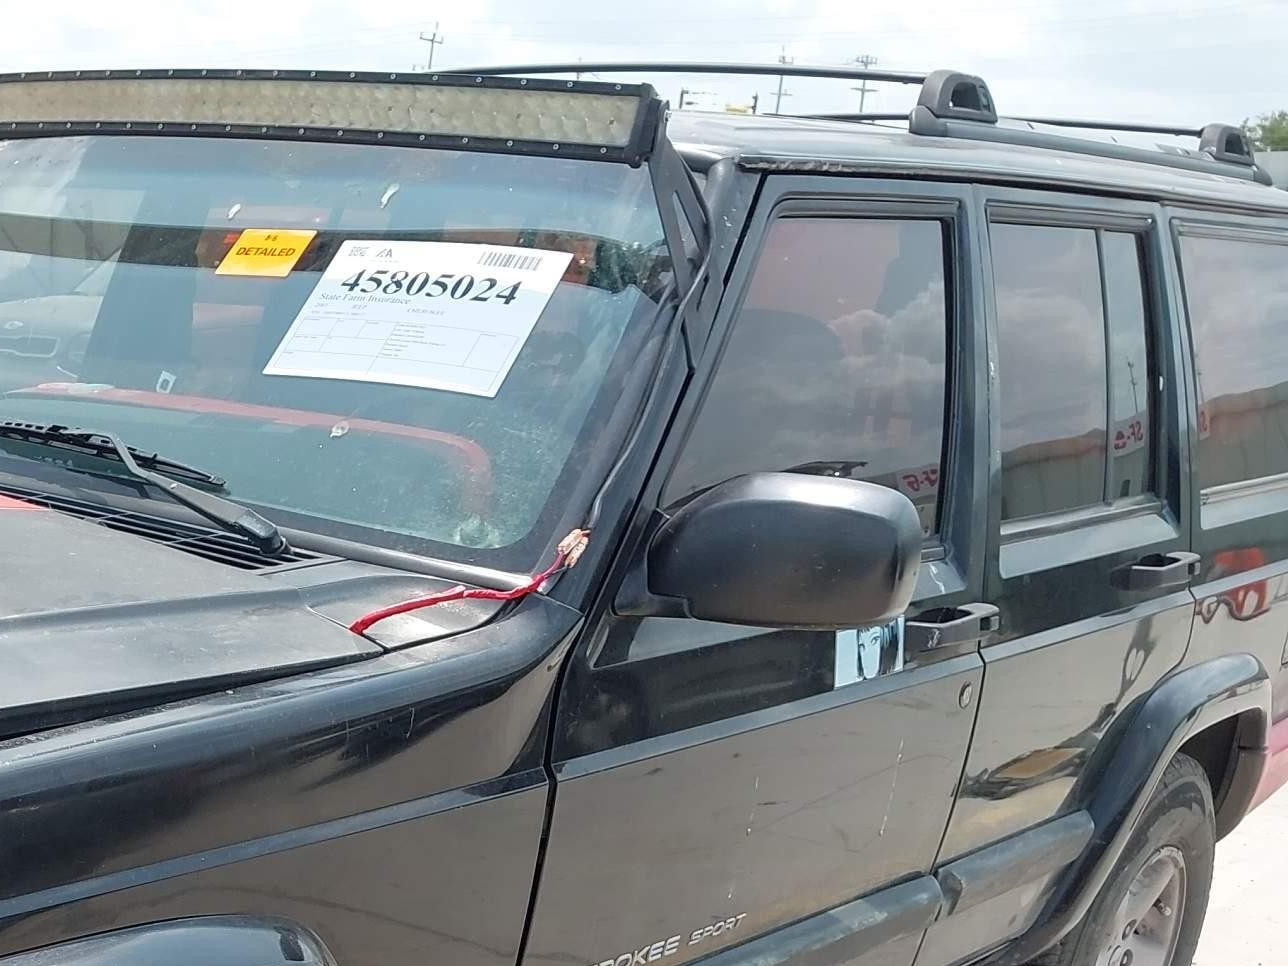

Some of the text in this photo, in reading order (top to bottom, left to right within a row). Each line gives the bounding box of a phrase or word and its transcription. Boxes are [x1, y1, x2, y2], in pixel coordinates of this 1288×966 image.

[235, 247, 297, 257] DETAILED
[340, 268, 524, 306] 45805024
[687, 912, 748, 946] SPORT
